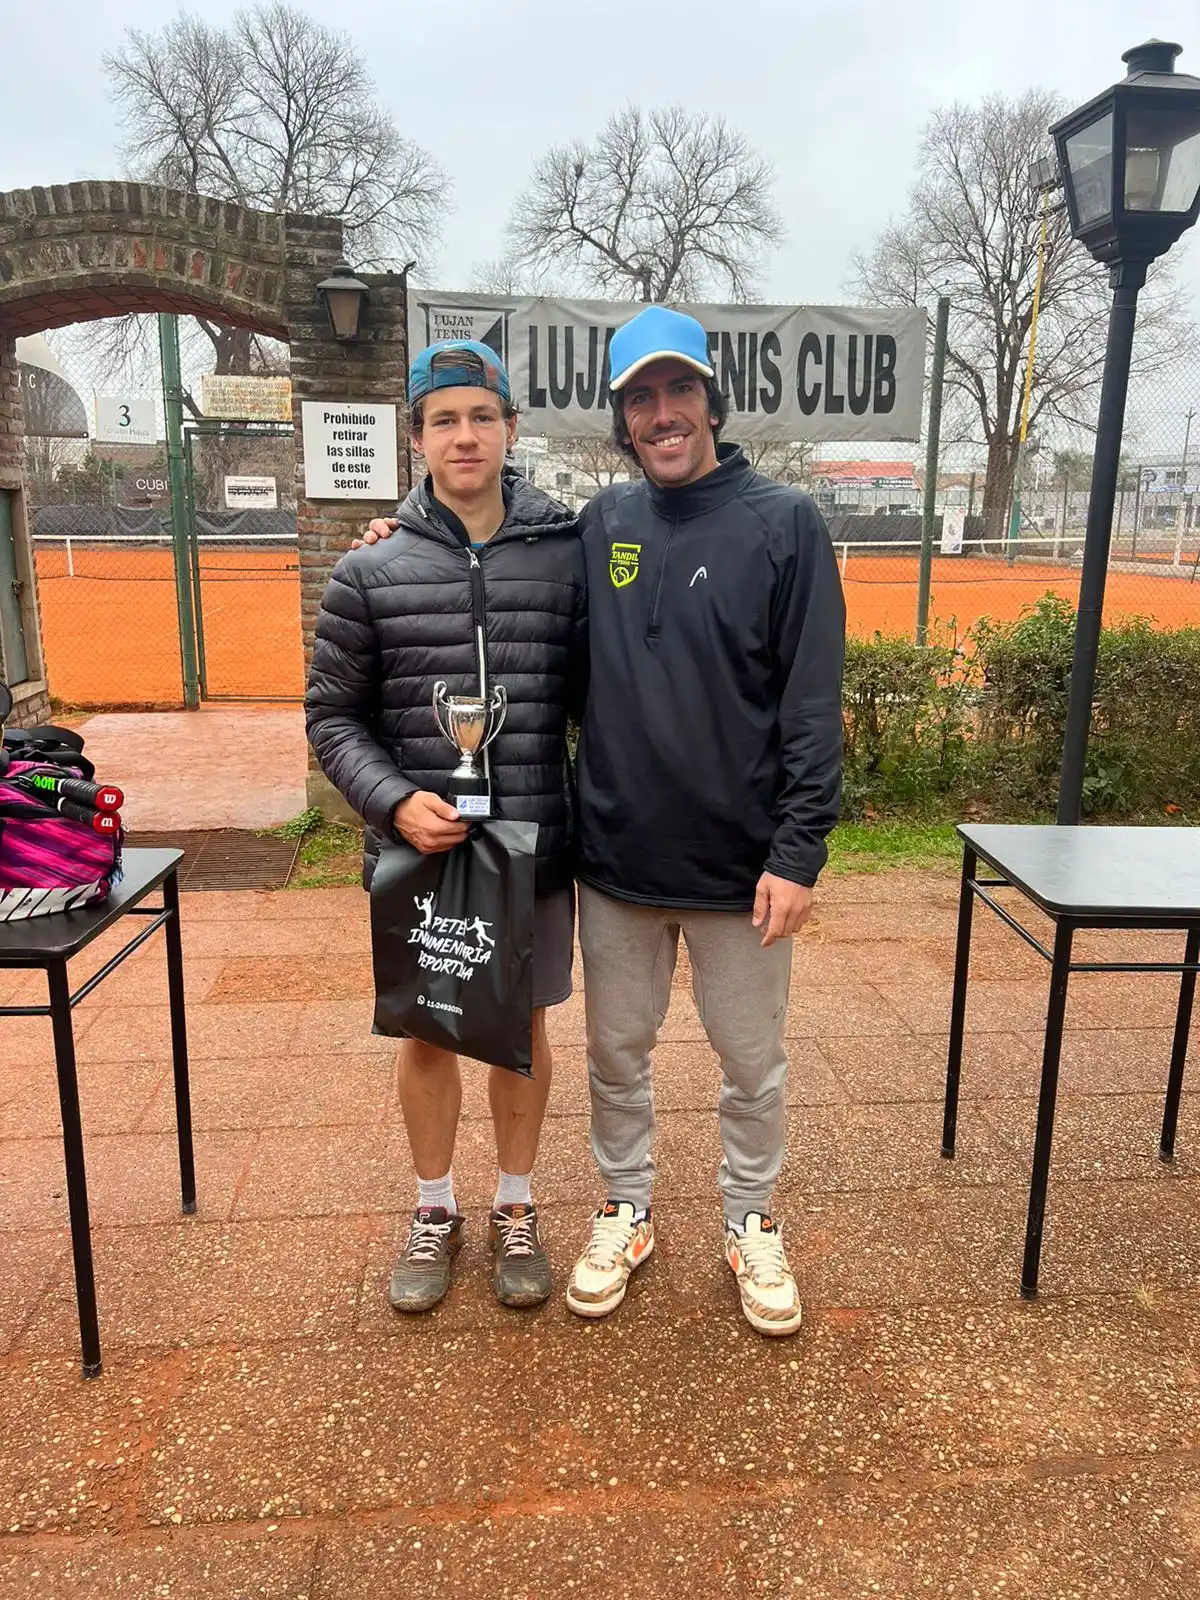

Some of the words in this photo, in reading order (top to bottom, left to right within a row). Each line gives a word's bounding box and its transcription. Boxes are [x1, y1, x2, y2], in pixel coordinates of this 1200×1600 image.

[434, 314, 473, 326] LUJAN
[434, 329, 471, 340] TENIS
[529, 325, 613, 410] LUJA
[797, 331, 897, 416] CLUB
[118, 404, 131, 427] 3
[323, 412, 376, 425] Prohibido
[333, 429, 368, 441] retirar
[326, 445, 343, 456] las
[345, 445, 375, 457] sillas
[332, 461, 345, 473] de
[347, 462, 371, 473] este
[334, 478, 371, 490] sector.
[612, 551, 639, 561] TANDIL
